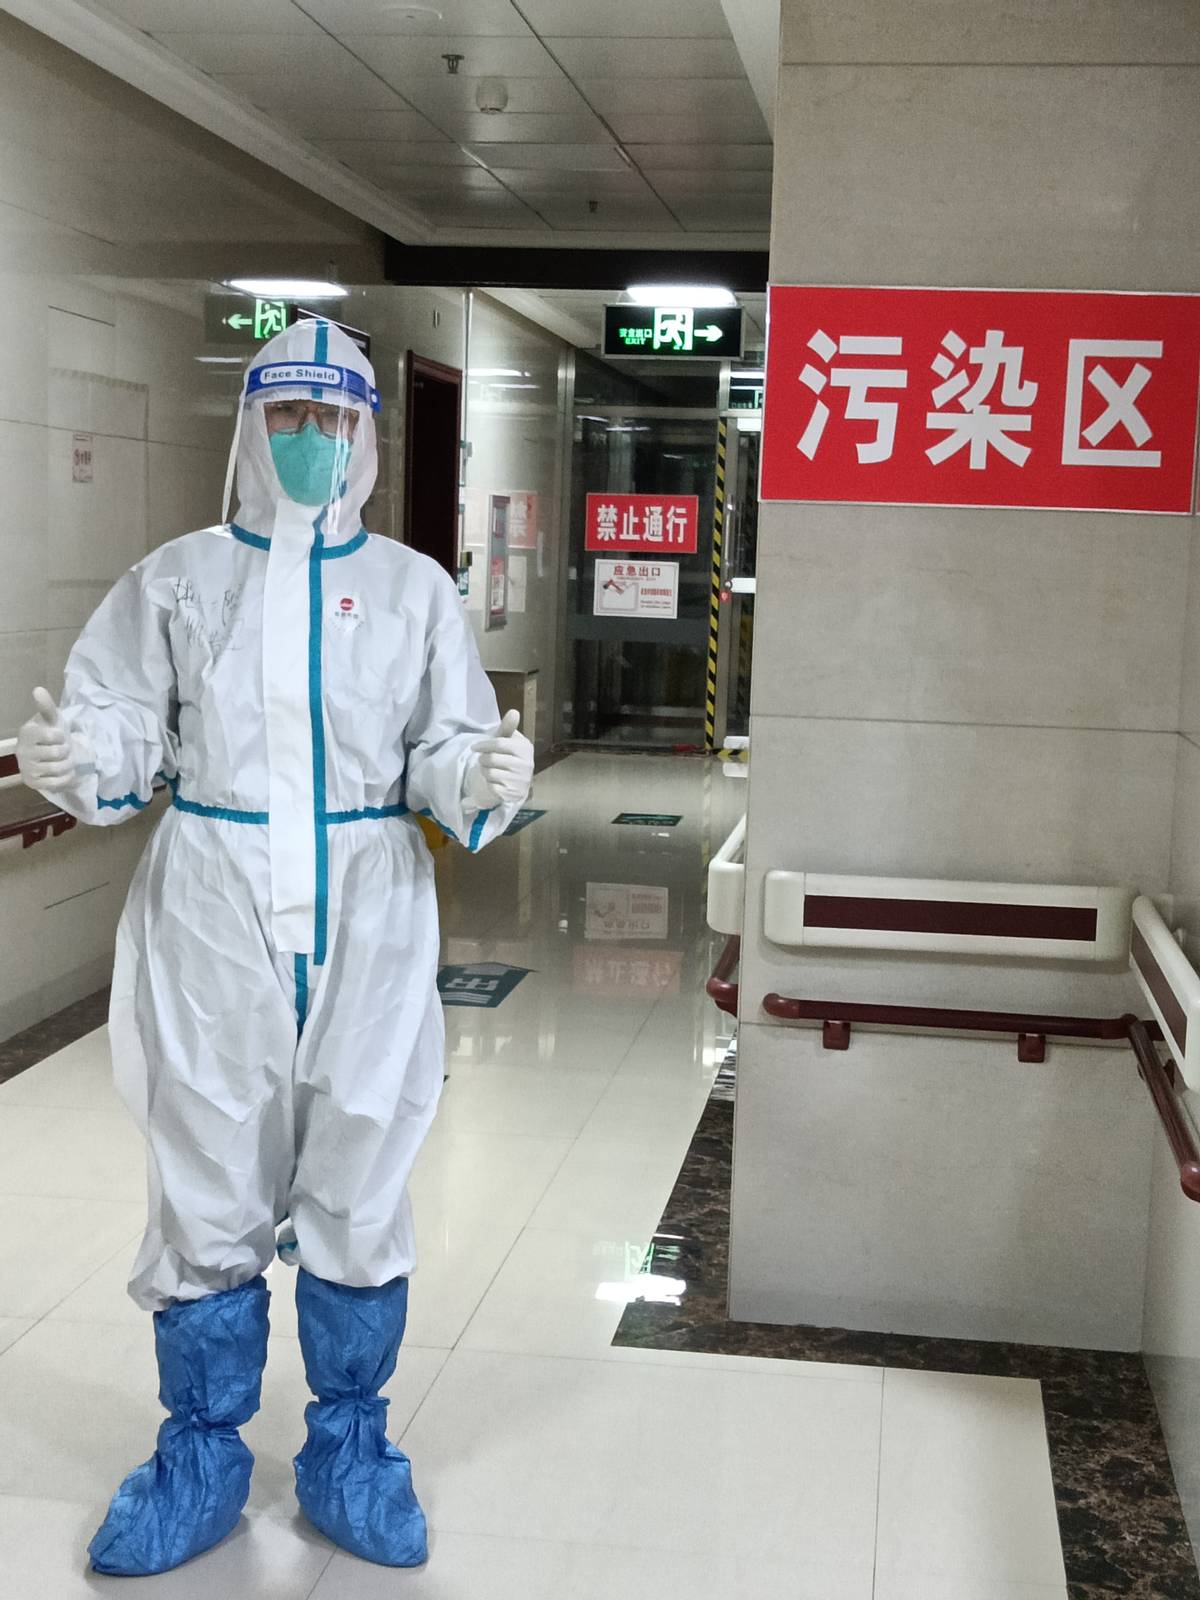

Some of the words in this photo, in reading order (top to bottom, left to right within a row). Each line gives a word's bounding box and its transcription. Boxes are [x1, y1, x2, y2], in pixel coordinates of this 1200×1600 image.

[625, 337, 646, 345] EXIT
[263, 370, 292, 380] Face
[295, 368, 335, 381] Shield
[796, 329, 1163, 470] 污染区
[597, 504, 688, 543] 禁止通行
[613, 564, 661, 577] 应急出口
